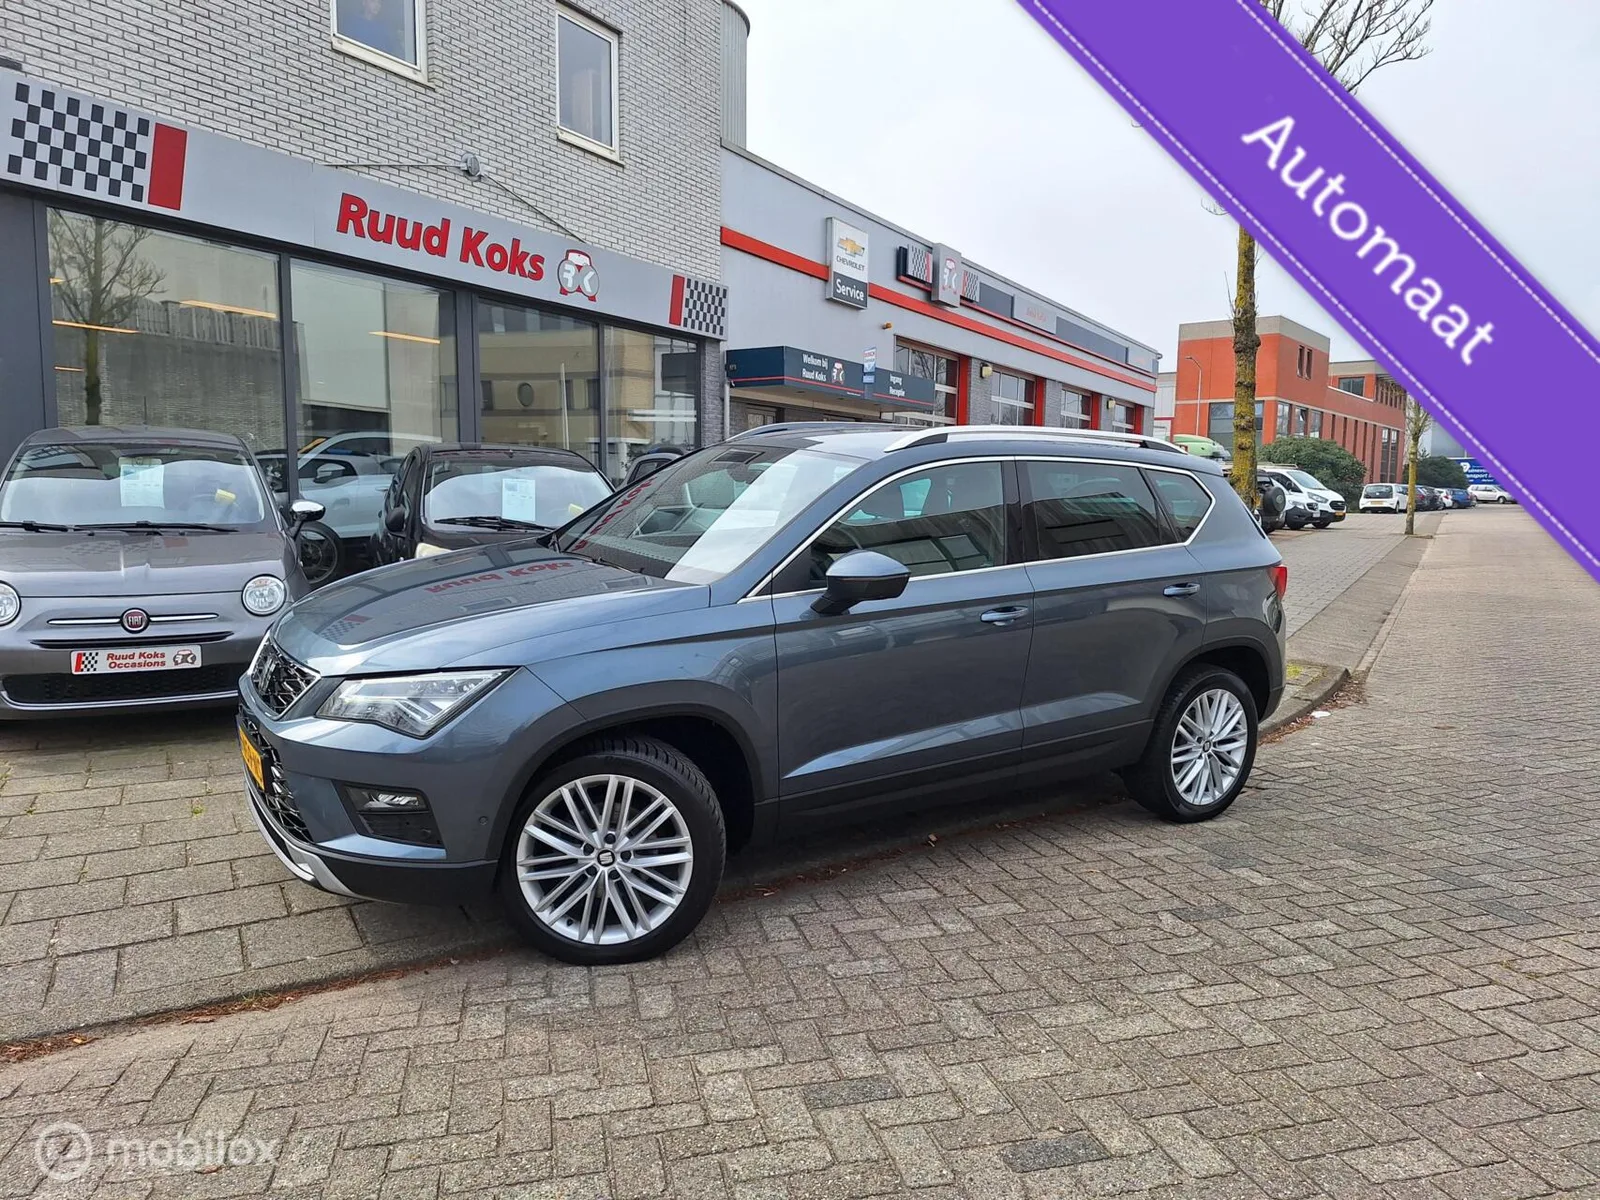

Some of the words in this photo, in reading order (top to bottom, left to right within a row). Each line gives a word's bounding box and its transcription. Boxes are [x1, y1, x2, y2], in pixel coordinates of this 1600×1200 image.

[336, 193, 451, 257] Ruud
[459, 226, 545, 281] Koks
[836, 255, 865, 271] CHEVROLET
[836, 279, 864, 301] Service
[128, 616, 143, 626] FIAT
[106, 652, 135, 661] Ruud
[138, 651, 166, 660] Koks
[108, 660, 166, 669] Occasions
